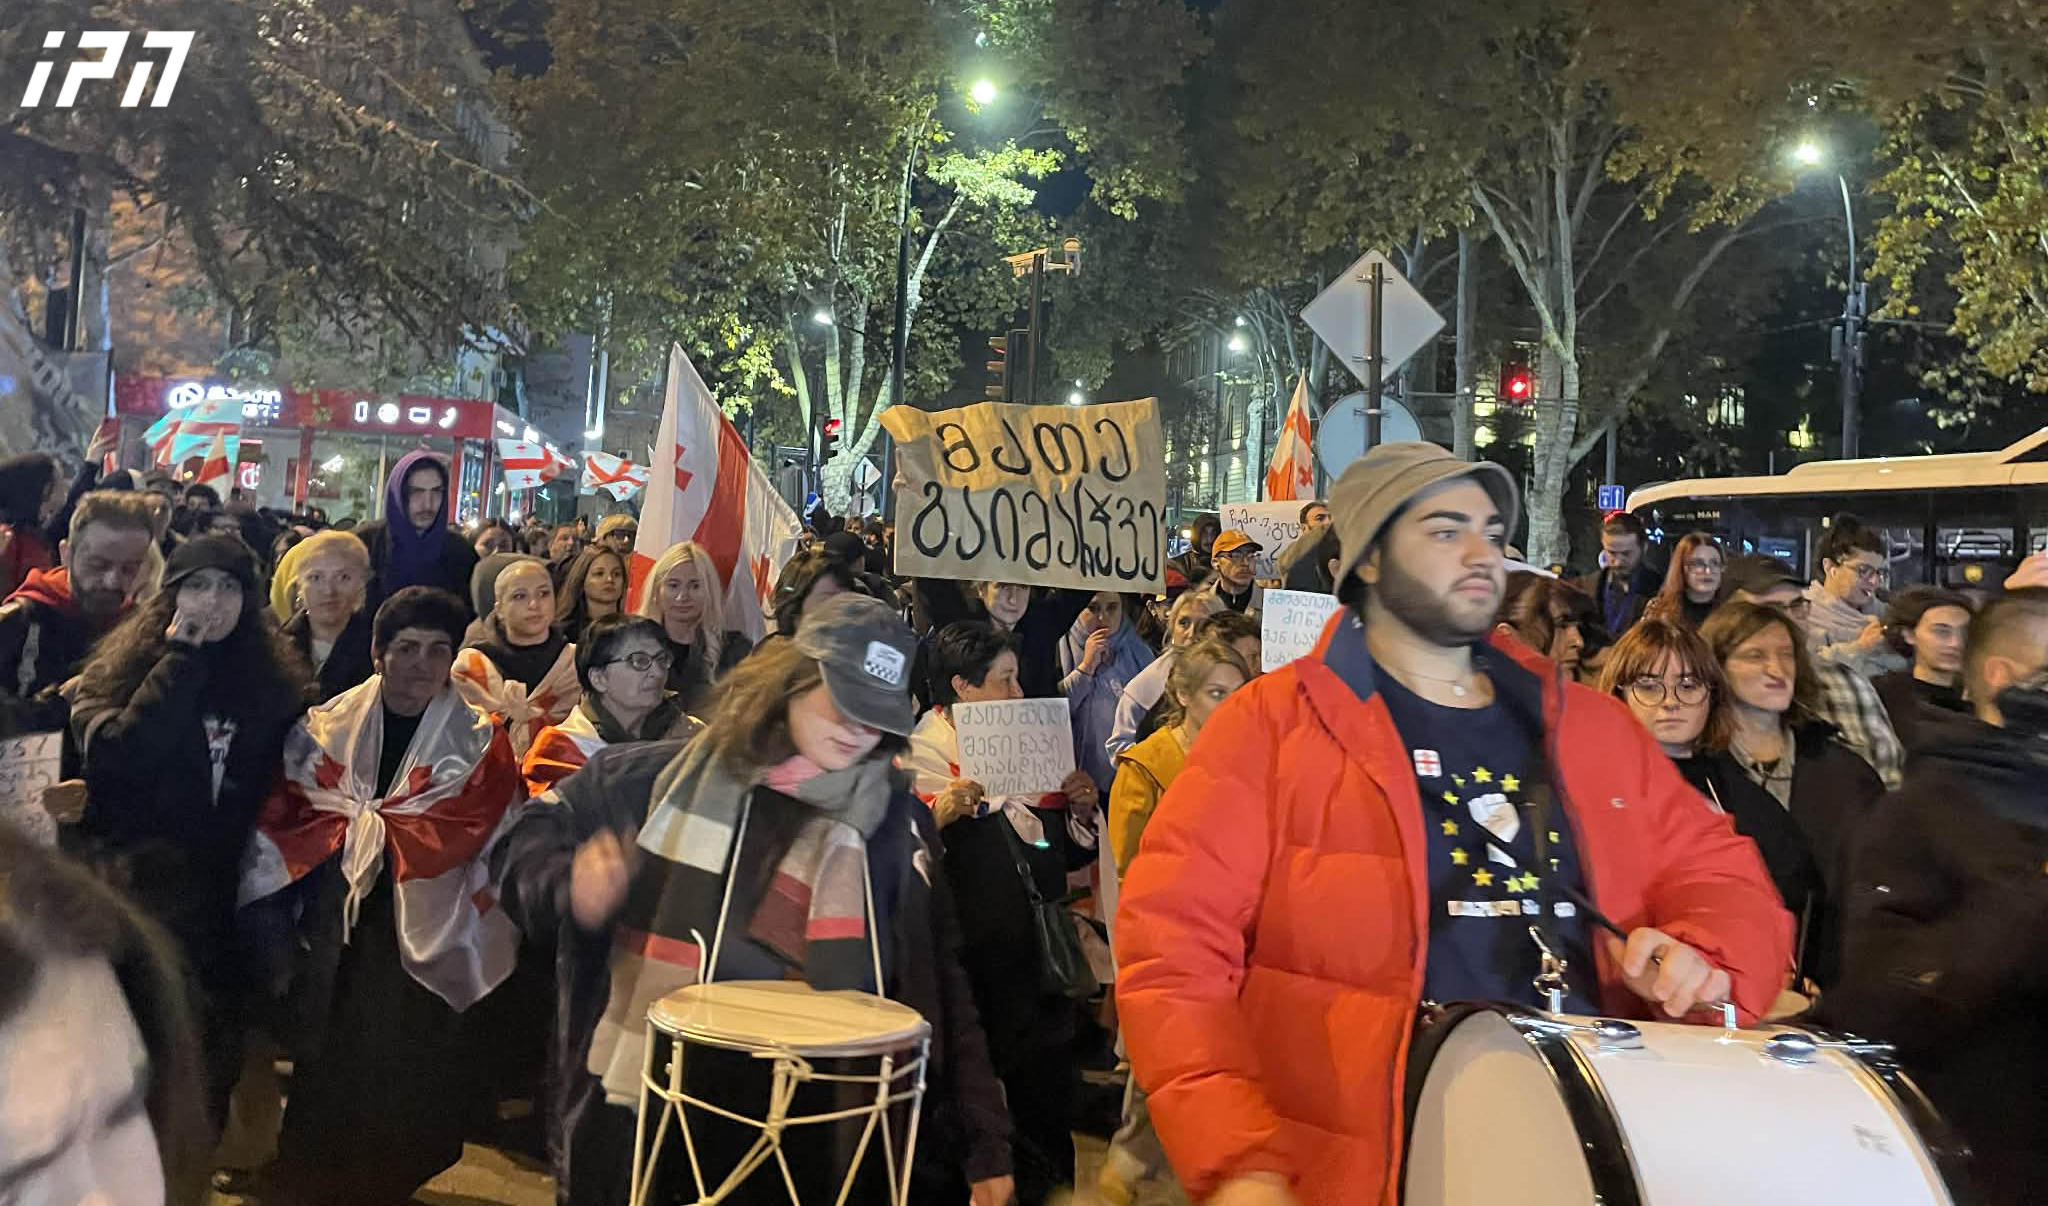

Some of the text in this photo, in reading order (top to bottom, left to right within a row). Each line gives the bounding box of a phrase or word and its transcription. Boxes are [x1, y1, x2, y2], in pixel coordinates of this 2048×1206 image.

[936, 417, 1132, 482] მათე
[911, 477, 1166, 581] გაიმარჯვე
[960, 704, 1014, 727] მათე
[963, 734, 1013, 757] შენი
